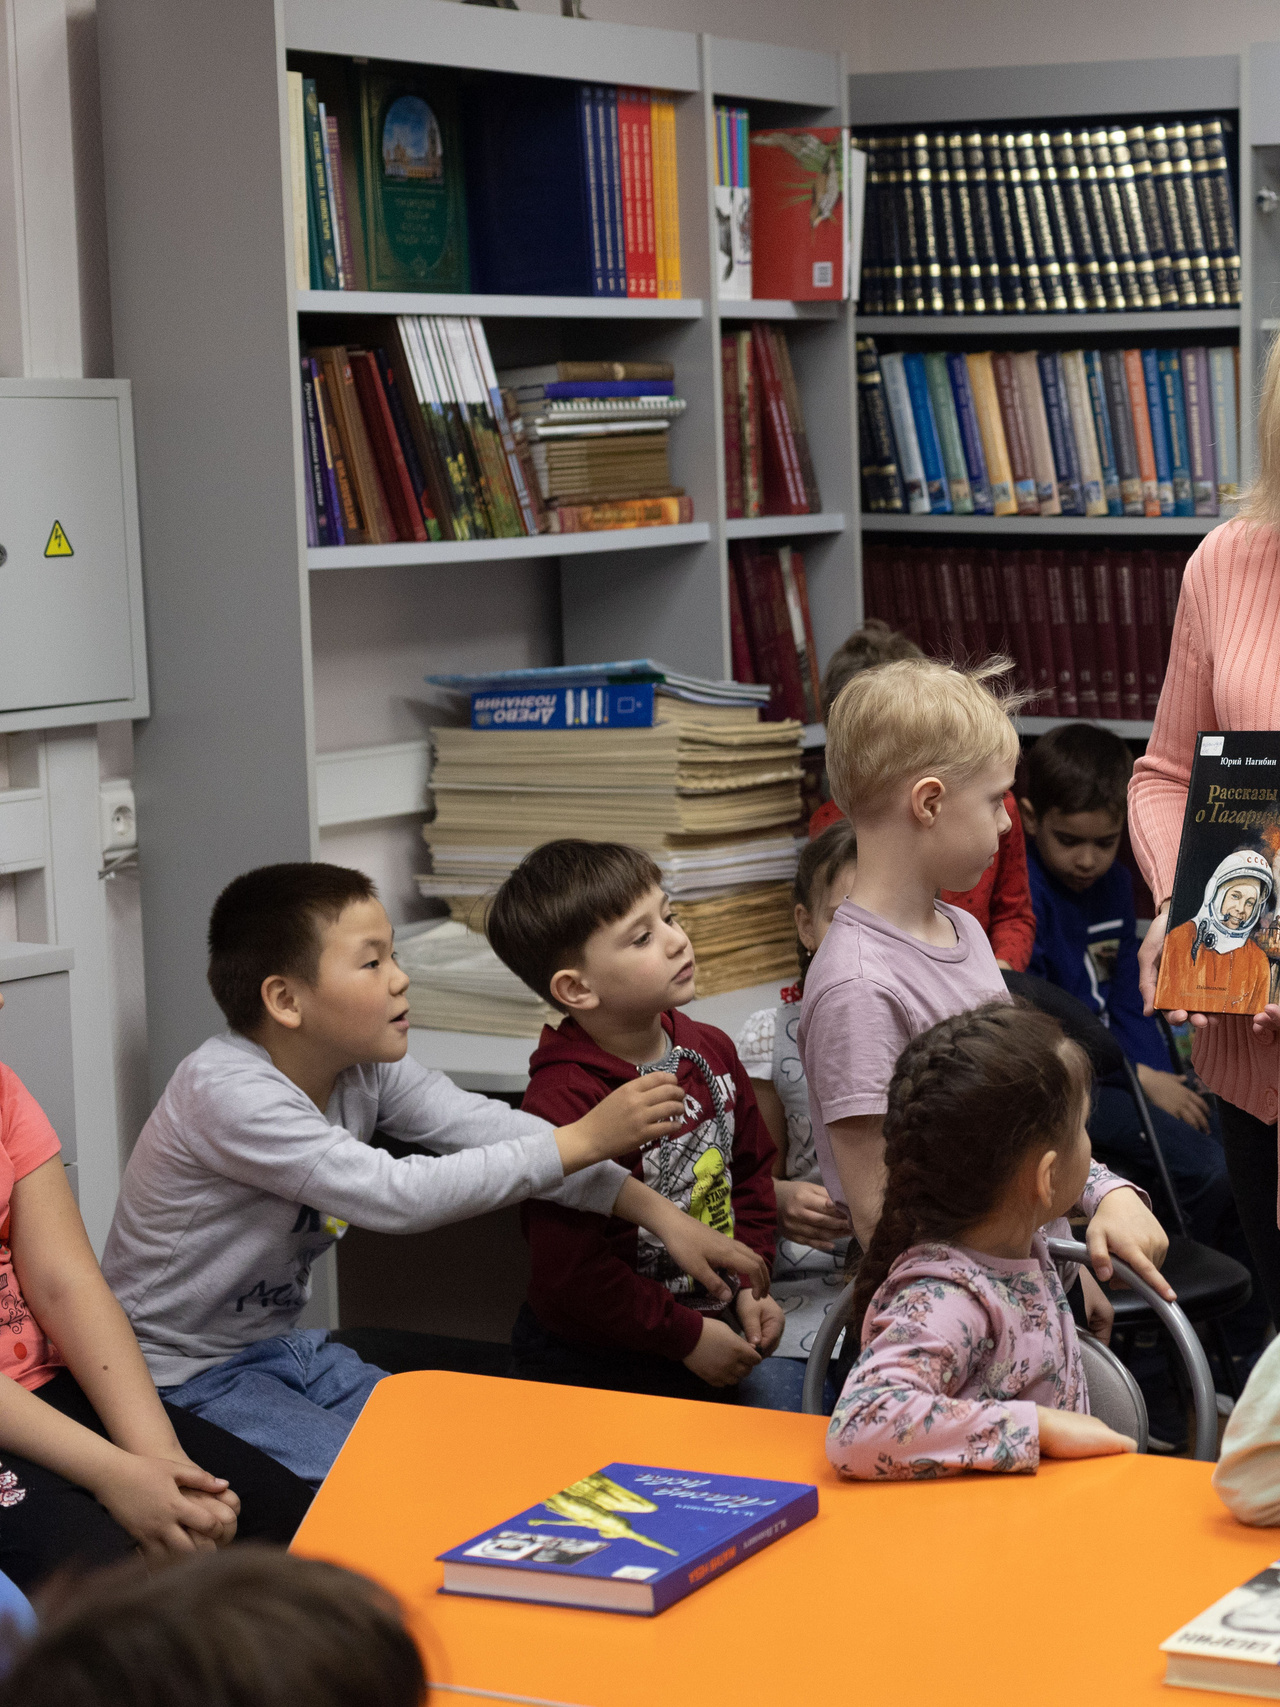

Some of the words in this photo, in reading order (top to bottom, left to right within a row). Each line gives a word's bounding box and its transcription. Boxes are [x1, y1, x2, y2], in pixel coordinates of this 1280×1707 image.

[474, 694, 558, 711] ПОЗНАНИЯ
[1220, 756, 1242, 768] Юрий
[1245, 756, 1278, 766] Нагибин
[1206, 784, 1279, 805] Рассказы
[1195, 809, 1206, 823] о
